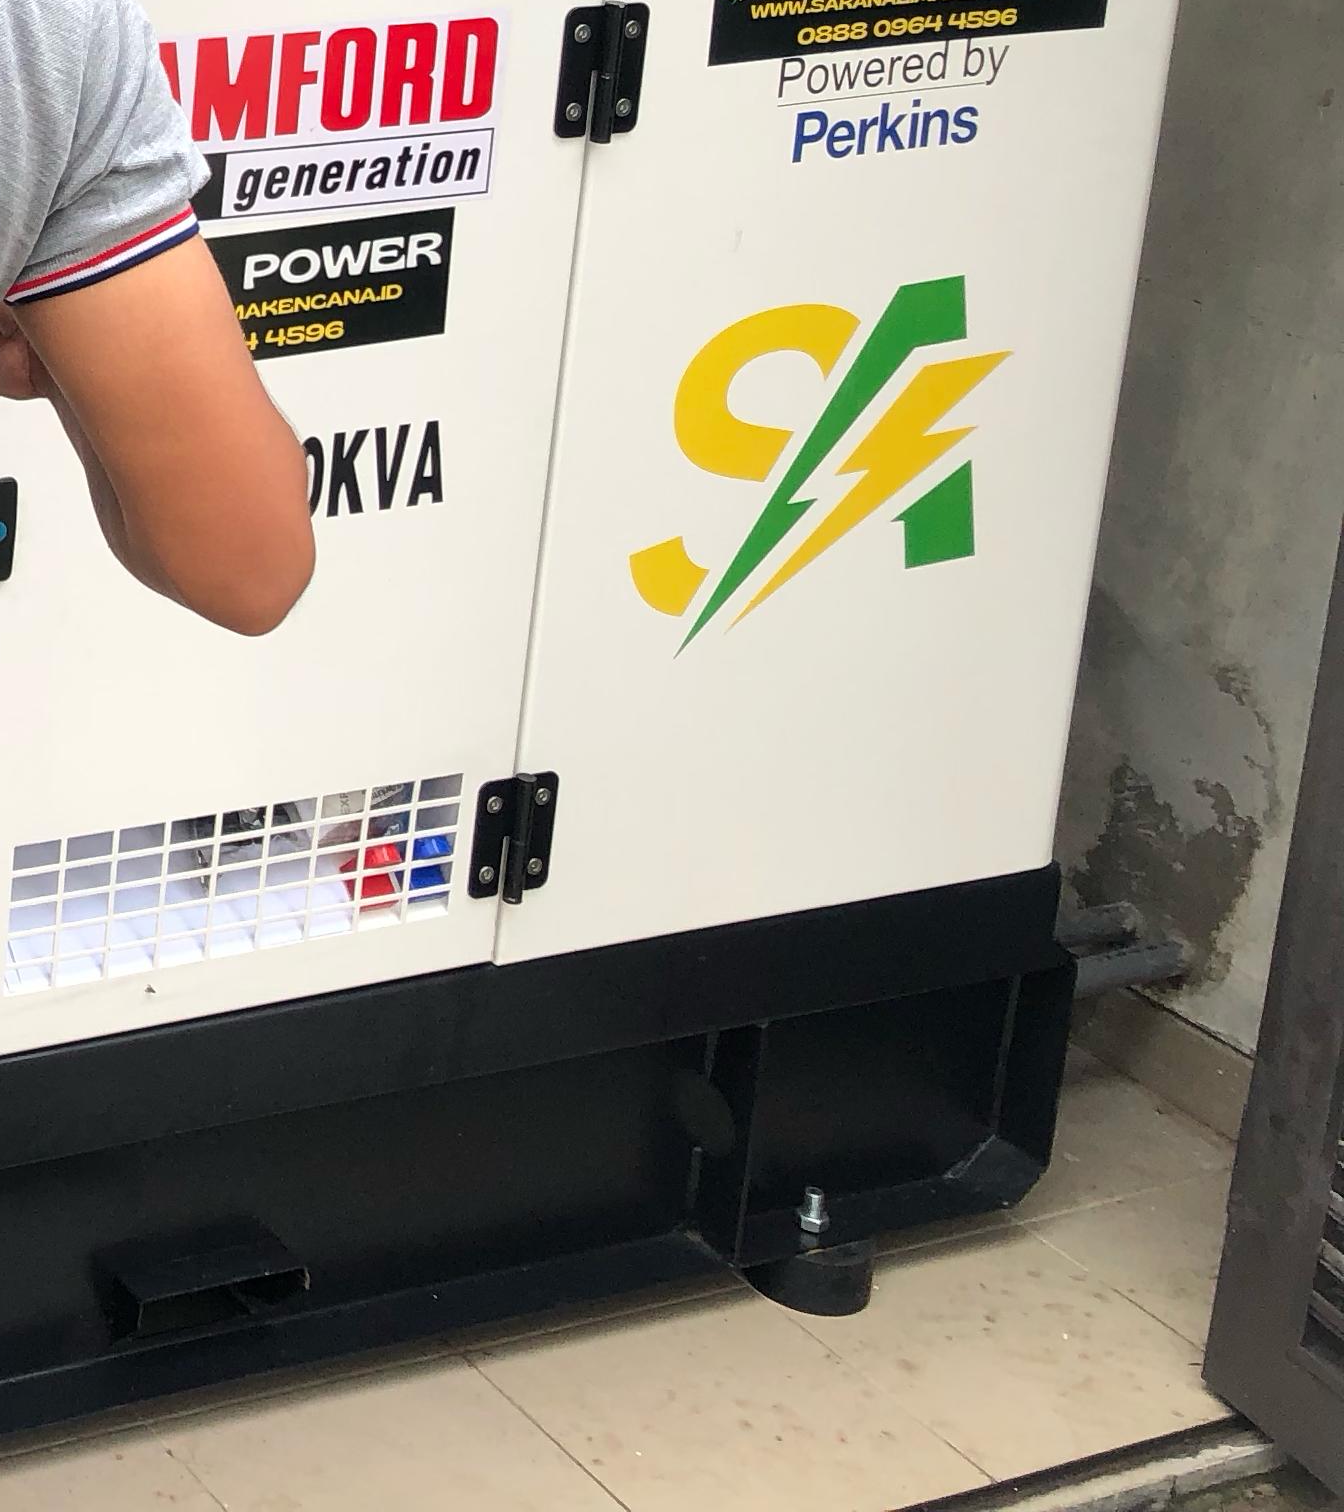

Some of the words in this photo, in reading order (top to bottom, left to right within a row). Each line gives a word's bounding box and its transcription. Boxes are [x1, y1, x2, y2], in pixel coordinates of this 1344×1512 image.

[797, 21, 868, 46] 0888
[873, 14, 943, 38] 0964
[948, 8, 1018, 32] 4596
[778, 40, 949, 98] Powered
[963, 39, 1010, 85] by
[792, 98, 979, 163] Perkins
[233, 142, 481, 213] generation
[243, 232, 443, 290] POWER
[265, 320, 345, 347] 4596
